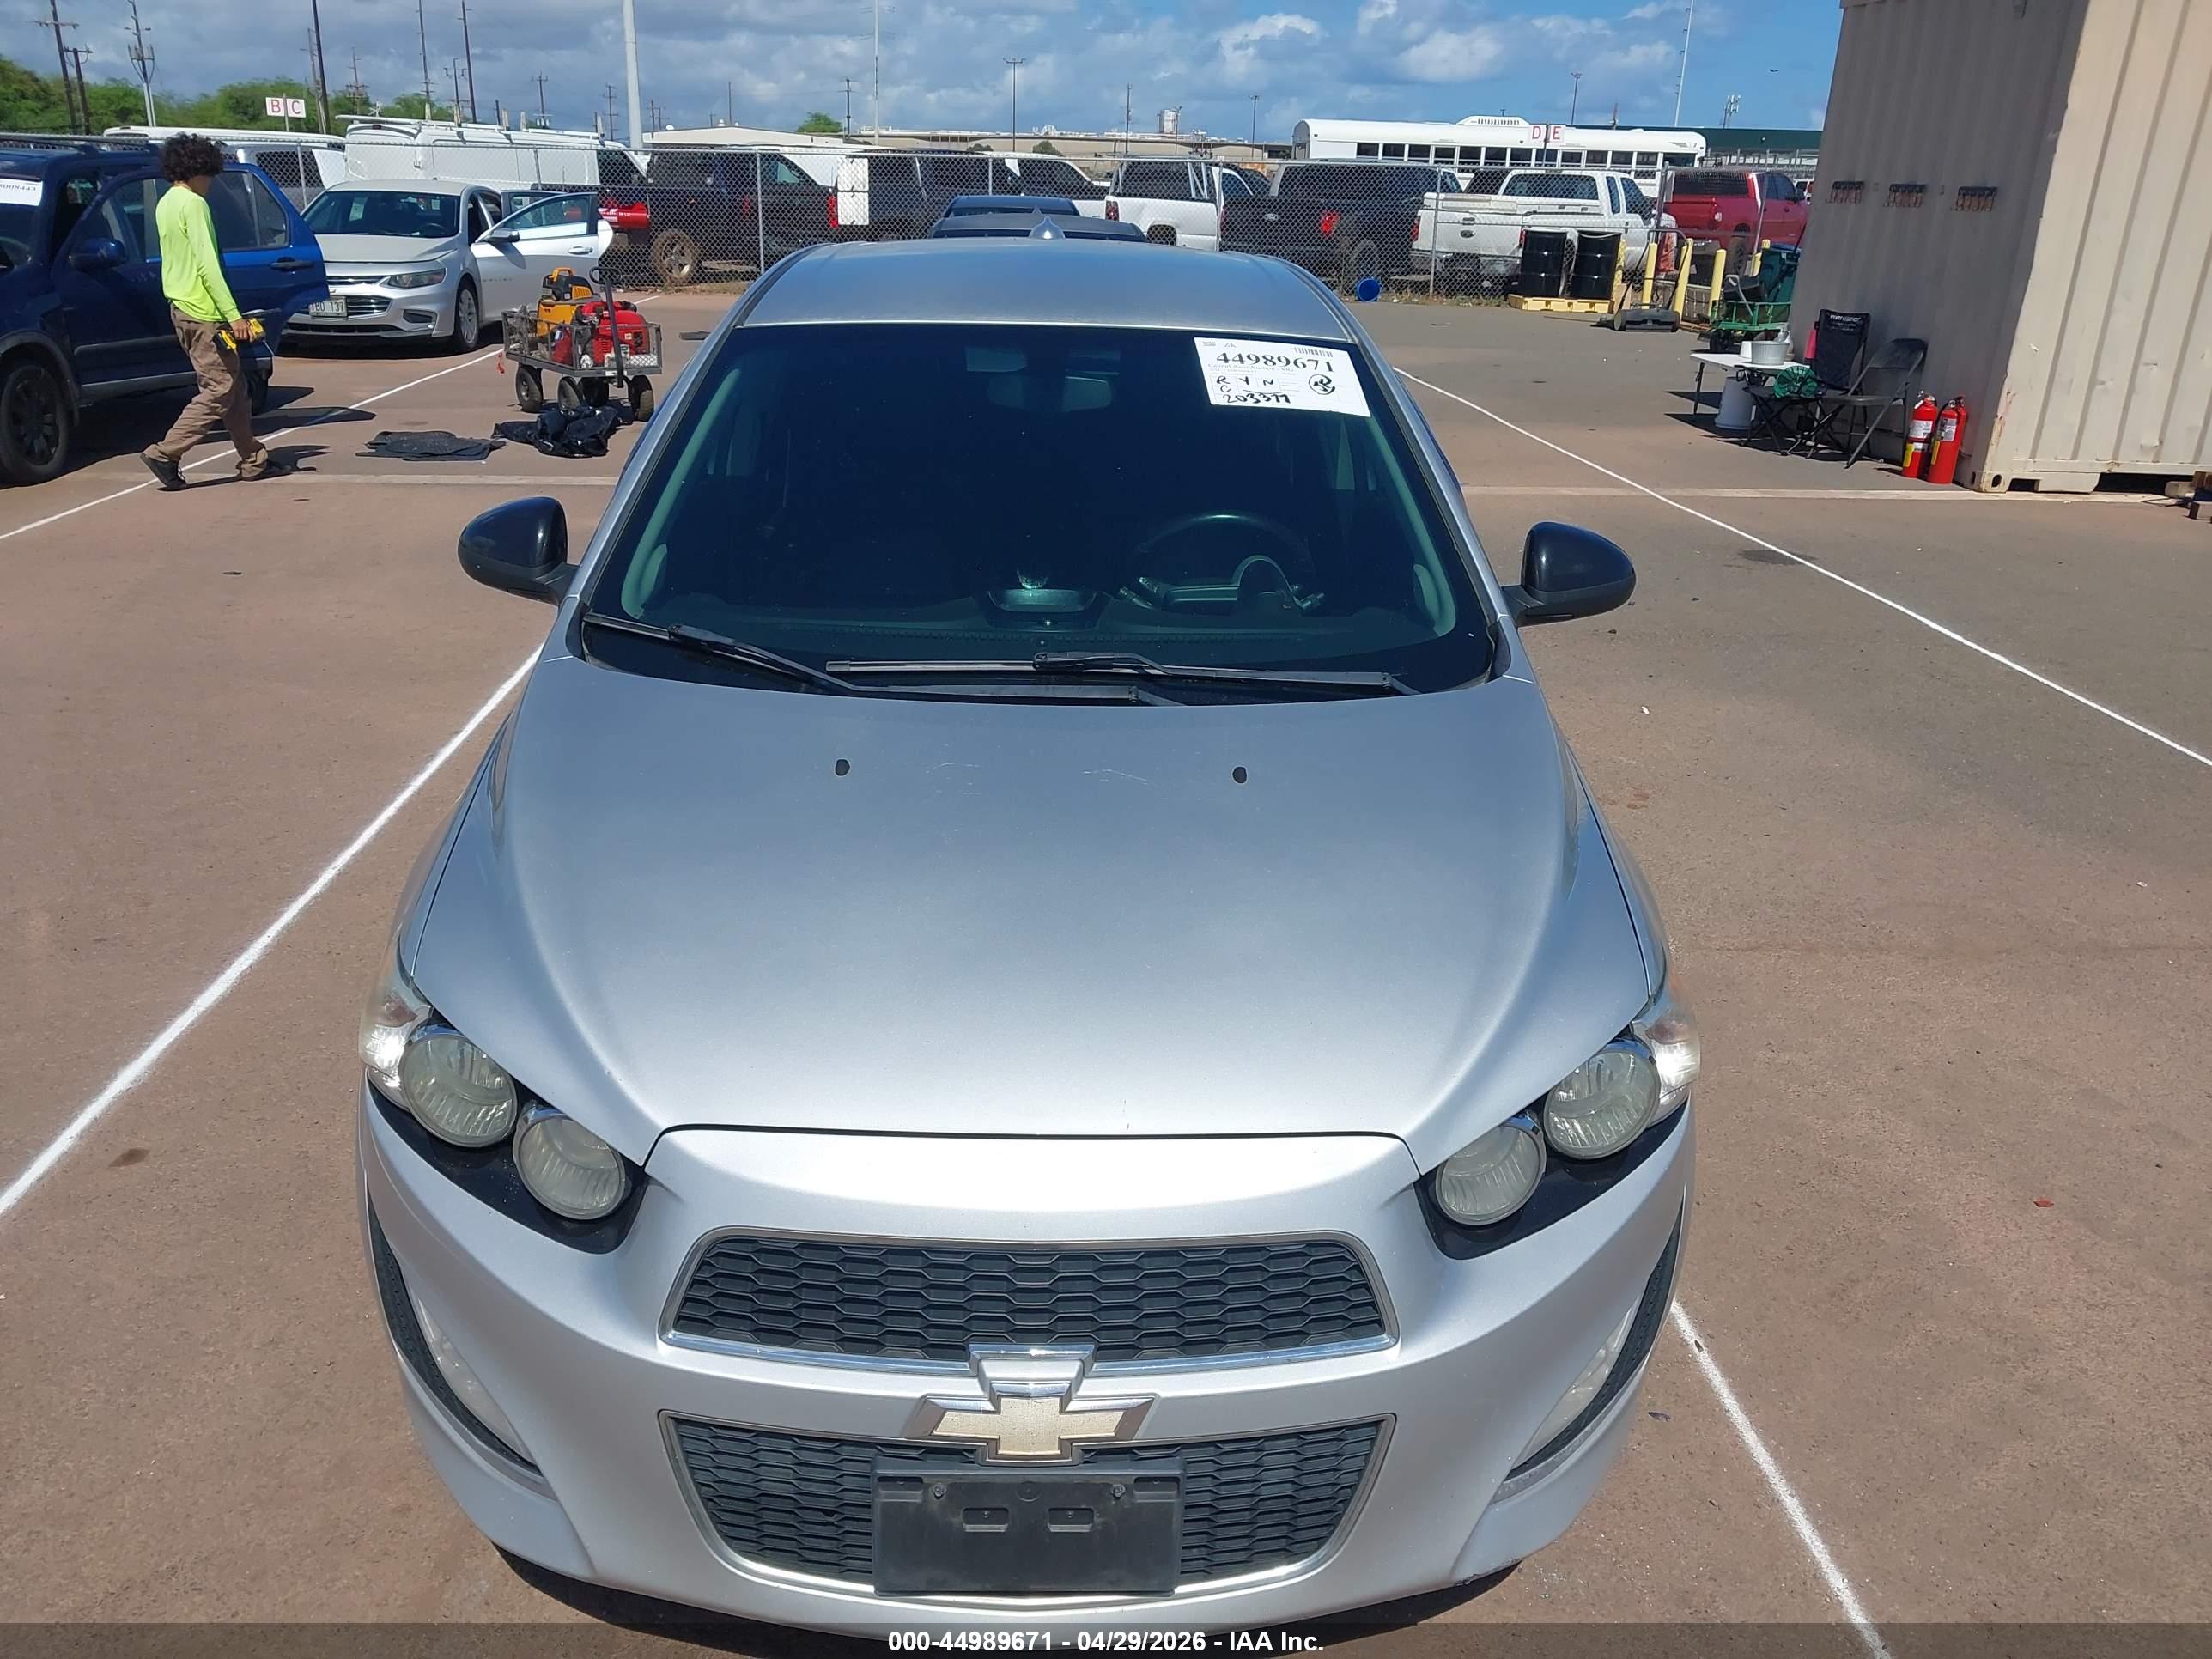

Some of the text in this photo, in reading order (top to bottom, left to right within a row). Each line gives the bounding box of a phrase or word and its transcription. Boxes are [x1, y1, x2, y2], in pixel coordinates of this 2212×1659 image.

[271, 99, 281, 112] B
[292, 100, 301, 114] C
[1532, 125, 1541, 139] D
[1553, 126, 1562, 139] E
[1216, 352, 1334, 372] 44989671
